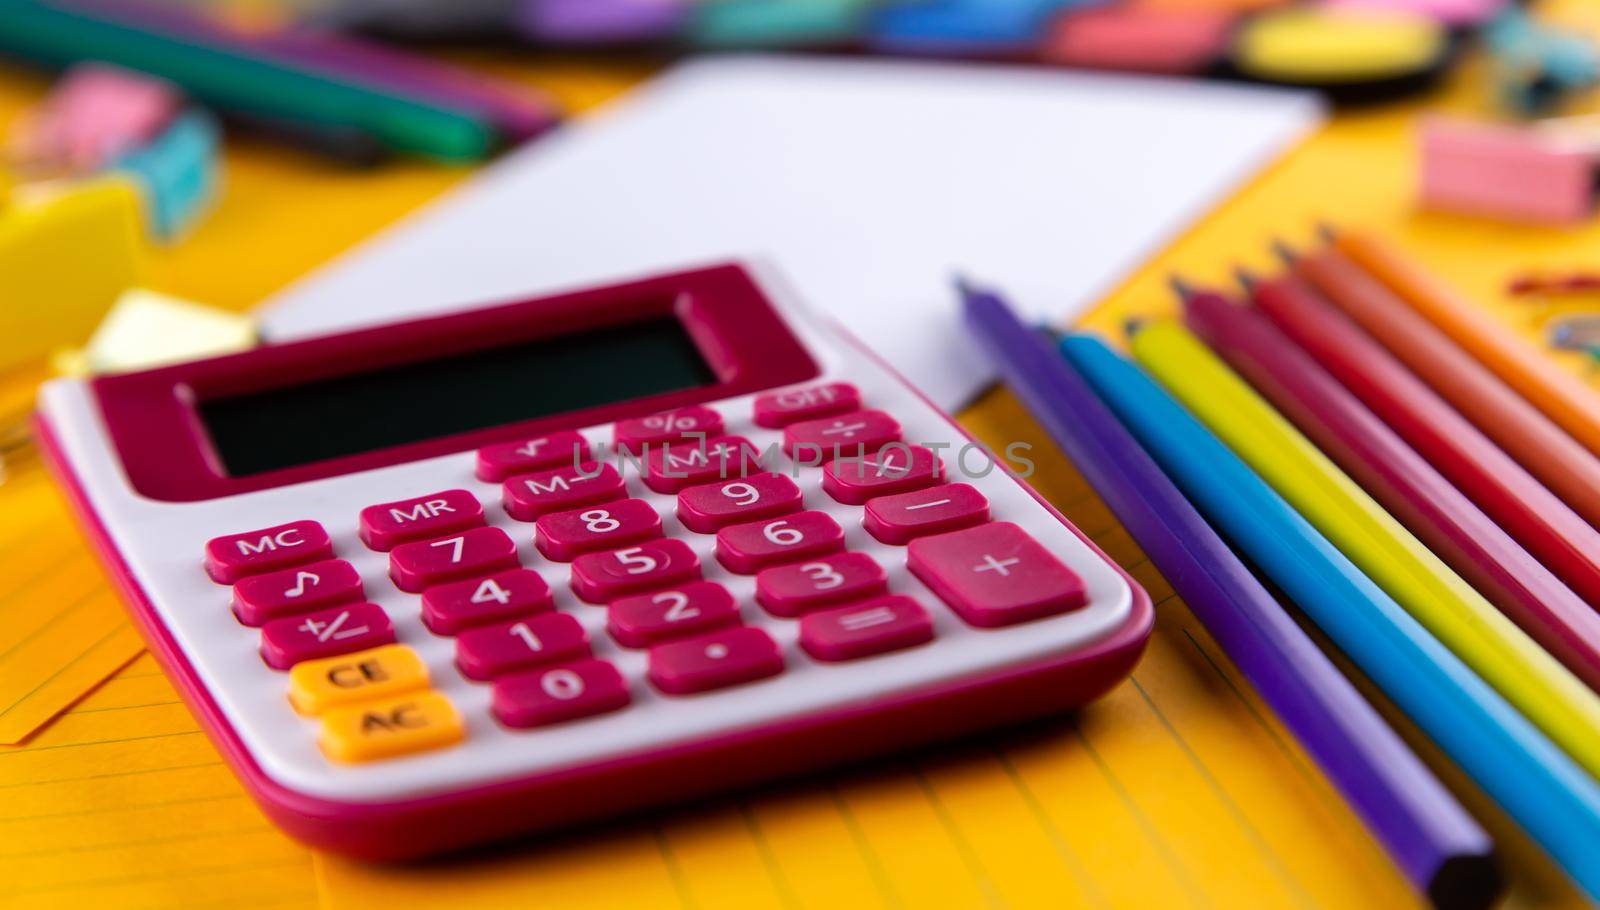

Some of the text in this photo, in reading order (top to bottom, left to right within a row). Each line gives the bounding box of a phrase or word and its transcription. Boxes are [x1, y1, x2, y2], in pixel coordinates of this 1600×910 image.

[776, 387, 839, 409] OFF
[643, 414, 697, 433] %
[667, 442, 737, 469] M+
[721, 482, 761, 506] 9
[389, 499, 457, 524] MR
[579, 510, 621, 533] 8
[236, 528, 305, 557] MC
[763, 521, 804, 546] 6
[430, 536, 465, 563] 7
[613, 546, 658, 575] 5
[800, 562, 845, 590] 3
[973, 554, 1020, 577] +
[469, 579, 512, 605] 4
[652, 591, 702, 622] 2
[509, 622, 544, 652] 1
[326, 658, 390, 689] CE
[540, 669, 584, 700] 0
[359, 703, 430, 735] AC
